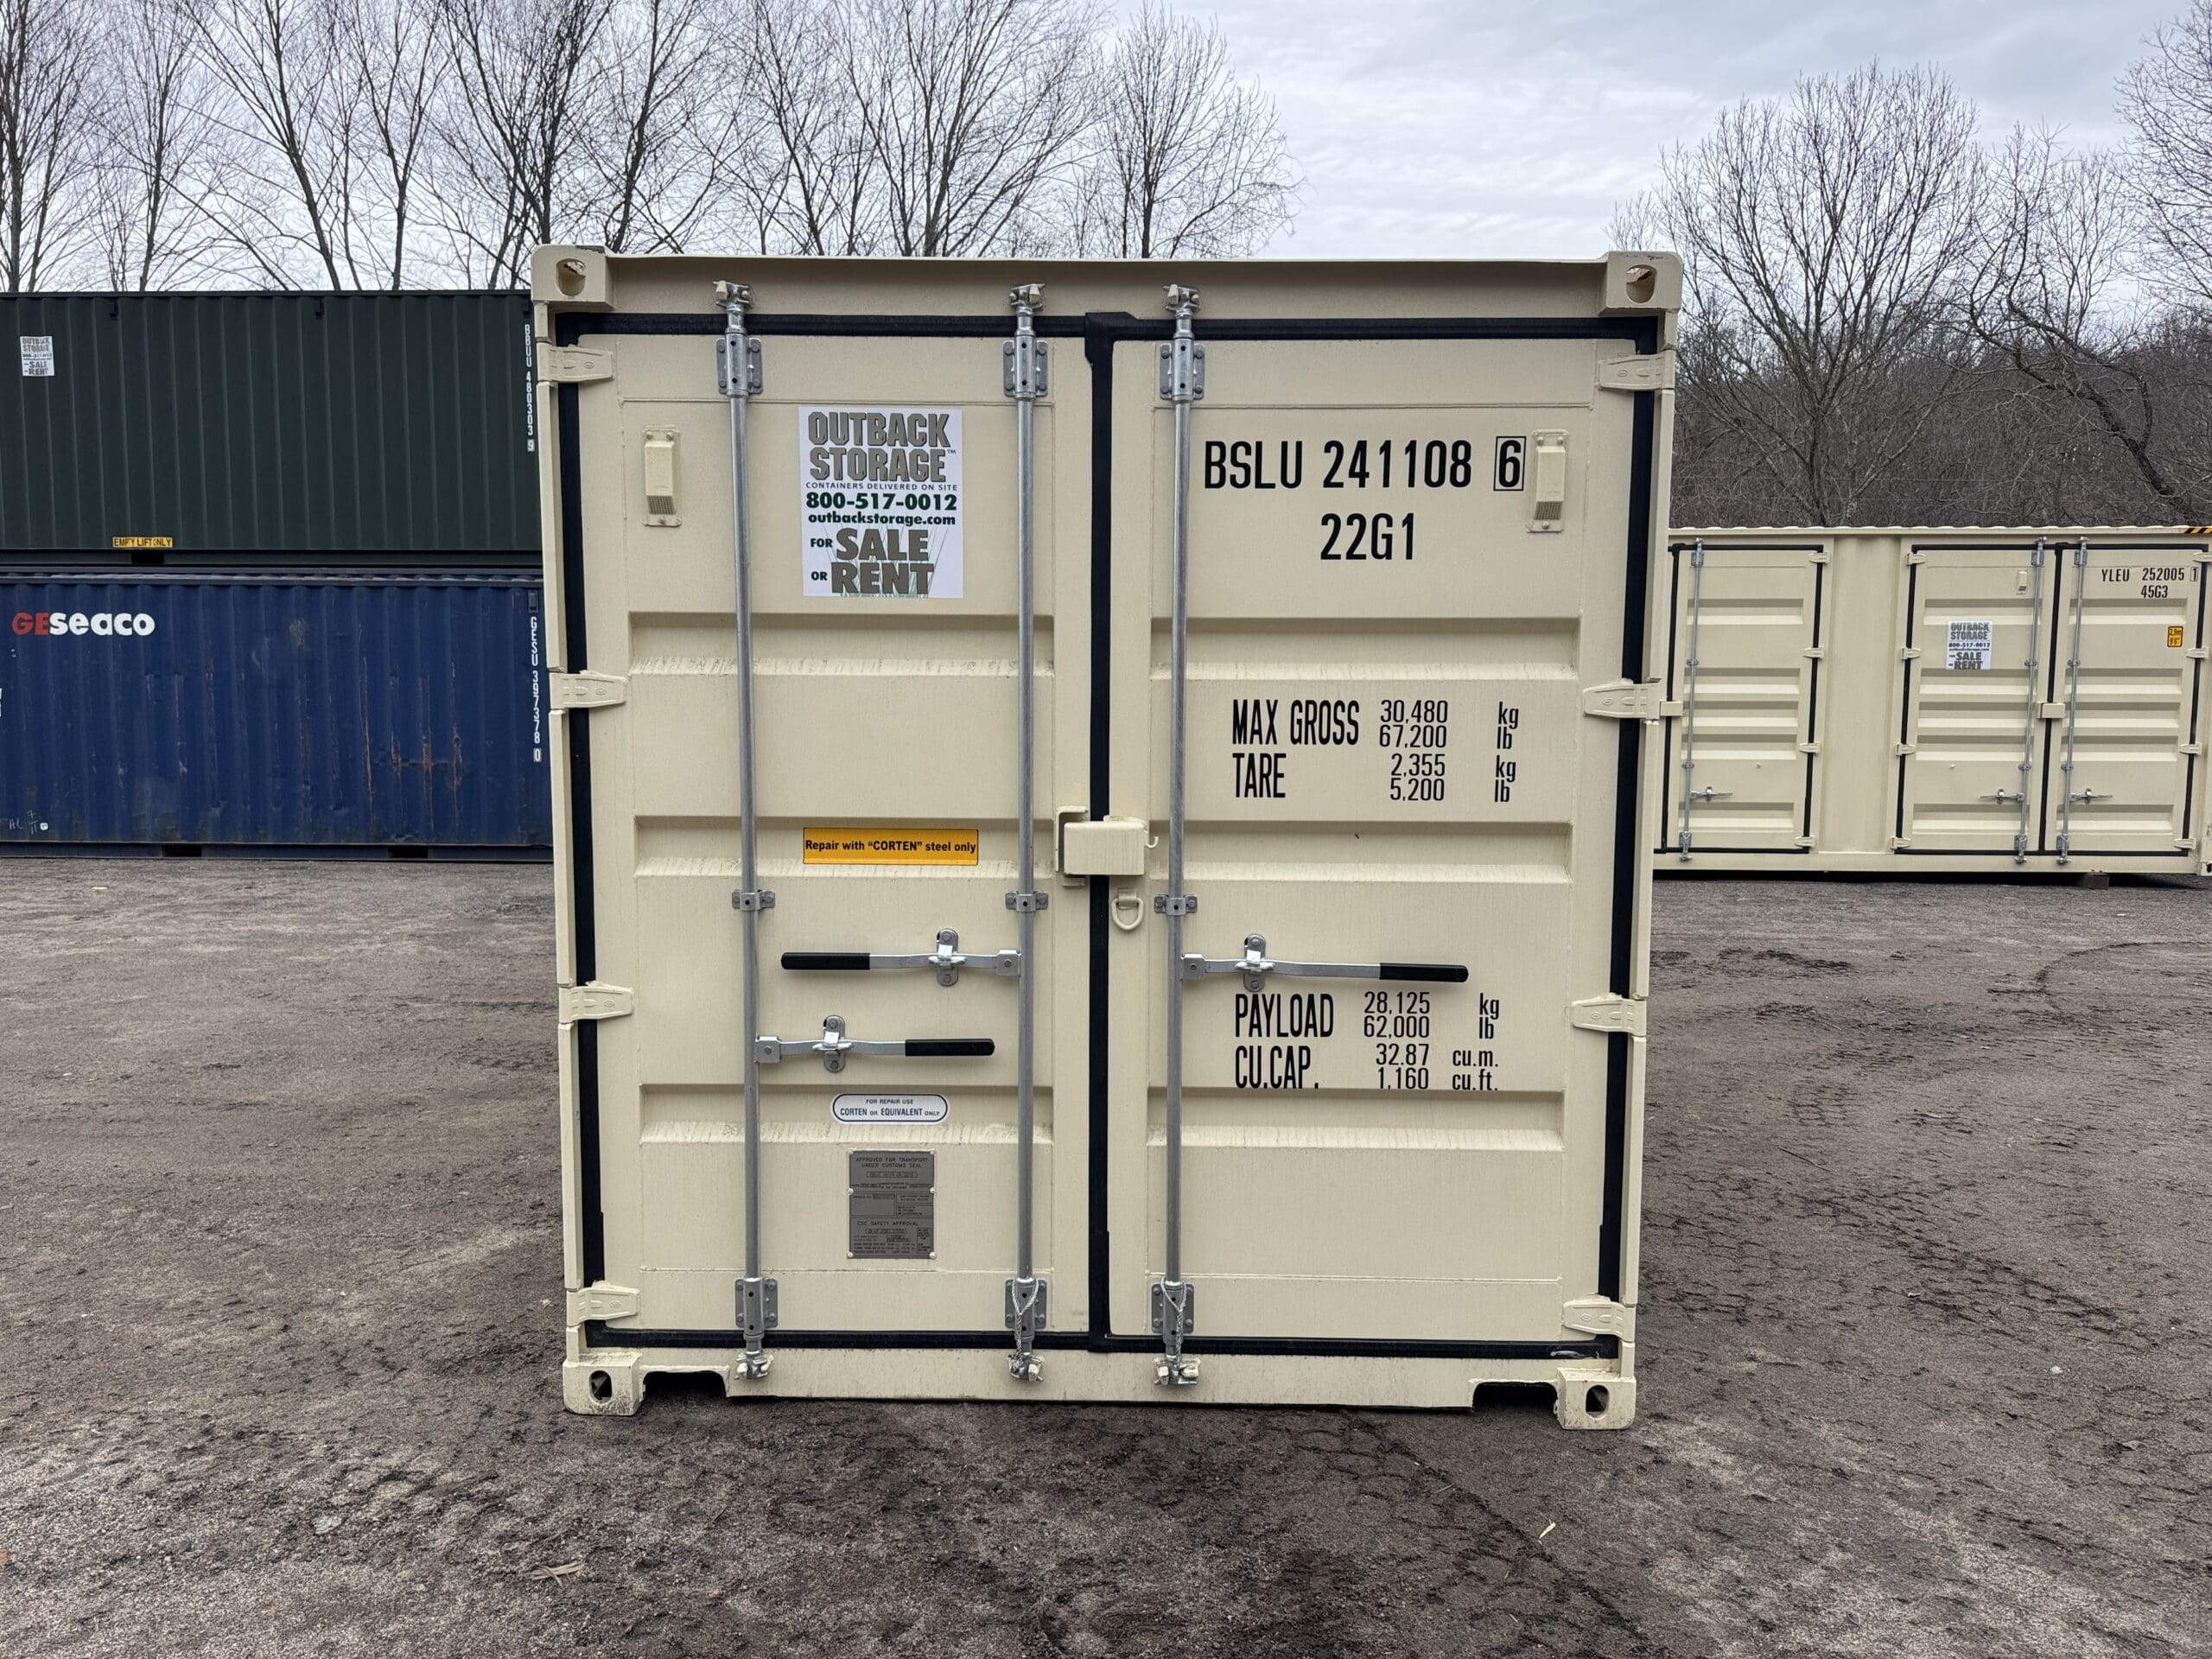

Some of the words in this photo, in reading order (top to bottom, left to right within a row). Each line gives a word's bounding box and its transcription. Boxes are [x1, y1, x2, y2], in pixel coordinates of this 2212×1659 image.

[525, 371, 534, 435] 480303
[808, 411, 950, 447] OUTBACK
[810, 447, 946, 482] STORAGE
[1205, 441, 1302, 489] BSLU
[1323, 440, 1471, 488] 241108
[1497, 440, 1522, 487] 6
[806, 492, 957, 511] 800-517-0012
[808, 512, 956, 526] outbackstorage.com
[810, 538, 833, 548] FOR
[836, 528, 929, 561] SALE
[1320, 512, 1414, 560] 22G1
[811, 571, 828, 581] OR
[830, 562, 934, 594] RENT
[2101, 569, 2130, 582] YLEU
[2142, 568, 2184, 581] 252005
[2140, 585, 2168, 598] 45G3
[1950, 622, 1990, 631] OUTBACK
[1950, 631, 1988, 639] STORAGE
[1954, 661, 1983, 670] RENT
[1955, 652, 1982, 660] SALE
[1232, 699, 1279, 745] MAX
[1290, 700, 1359, 745] GROSS
[1380, 699, 1448, 723] 30,480
[1498, 702, 1519, 729] kg
[1379, 725, 1447, 748] 67,200
[1497, 726, 1513, 749] lb
[534, 749, 541, 762] 0
[1232, 753, 1287, 798] TARE
[1390, 753, 1446, 778] 2,355
[1496, 754, 1516, 782] kg
[1389, 778, 1445, 801] 5,200
[1494, 779, 1510, 803] lb
[805, 840, 839, 852] Repair
[842, 841, 864, 850] with
[868, 841, 922, 850] “CORTEN”
[925, 842, 951, 851] steel
[954, 842, 976, 854] only
[1235, 994, 1334, 1038] PAYLOAD
[1363, 991, 1430, 1014] 28,125
[1479, 993, 1500, 1020] kg
[1363, 1015, 1430, 1039] 62,000
[1478, 1017, 1495, 1039] lb
[1376, 1043, 1429, 1065] 32.87
[1452, 1049, 1499, 1067] cu.m.
[1377, 1067, 1429, 1090] 1,160
[1452, 1069, 1498, 1091] cu.ft.
[840, 1108, 868, 1116] CORTEN
[880, 1108, 923, 1116] EQUIVALENT
